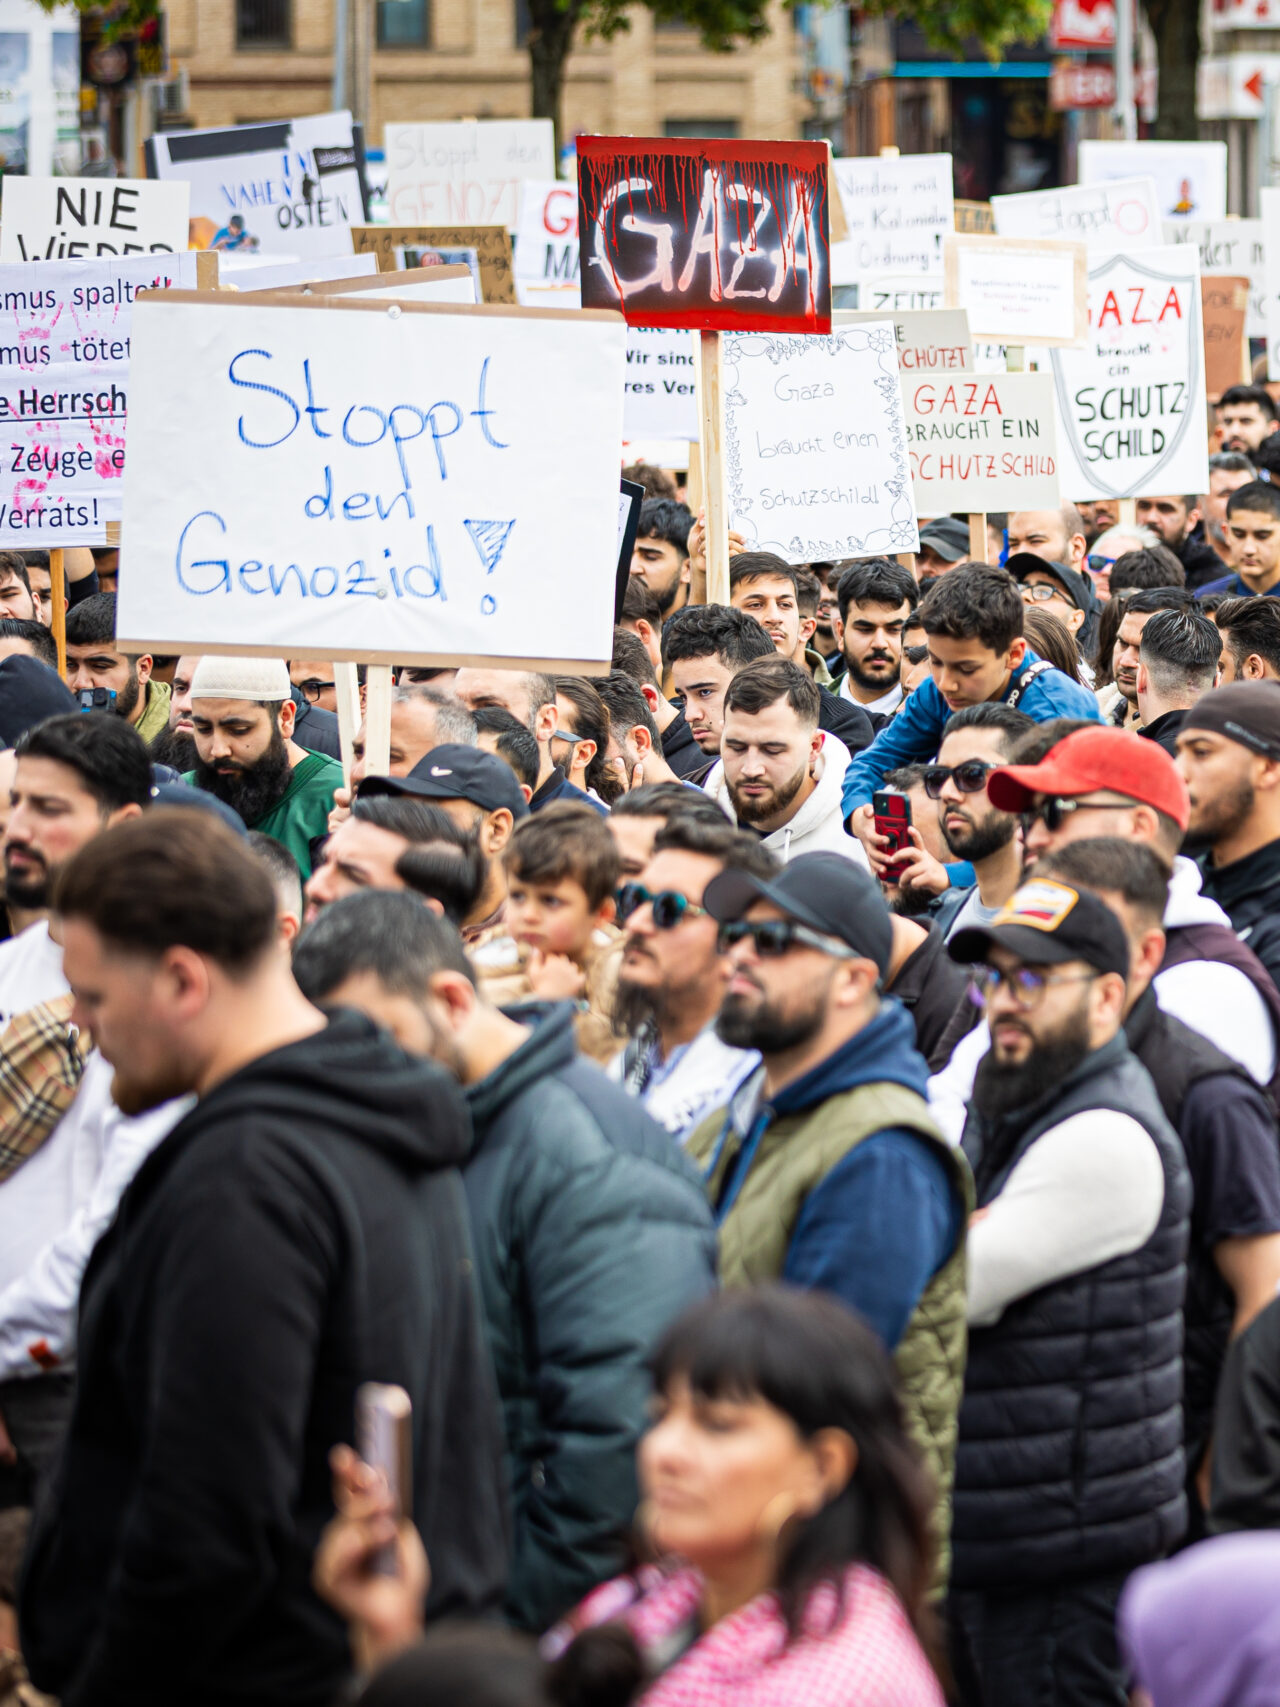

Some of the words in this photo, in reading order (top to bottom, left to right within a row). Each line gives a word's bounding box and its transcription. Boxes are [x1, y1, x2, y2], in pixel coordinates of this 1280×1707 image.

[56, 187, 139, 231] NIE
[277, 196, 349, 230] OSTEN
[593, 167, 820, 319] GAZA
[1087, 286, 1183, 328] AZA
[897, 345, 968, 369] CHÜTZT
[775, 374, 834, 402] Gaza
[914, 383, 1003, 416] GAZA
[229, 349, 510, 490] Stoppt
[1002, 418, 1040, 438] EIN
[757, 431, 827, 458] braucht
[833, 431, 880, 449] einen
[1085, 429, 1165, 462] SCHILD
[11, 446, 93, 479] Zeuge
[304, 465, 416, 521] den
